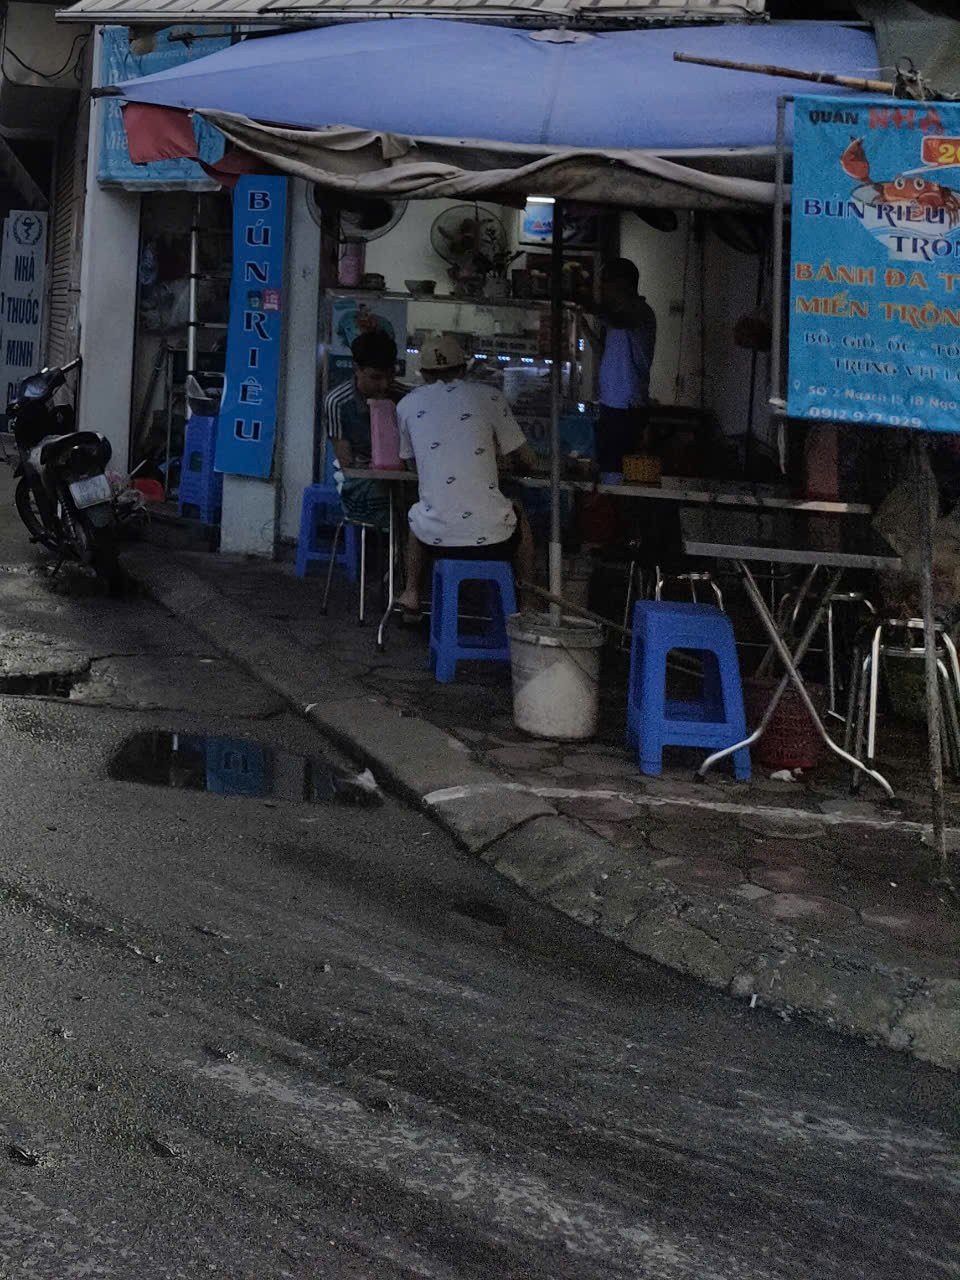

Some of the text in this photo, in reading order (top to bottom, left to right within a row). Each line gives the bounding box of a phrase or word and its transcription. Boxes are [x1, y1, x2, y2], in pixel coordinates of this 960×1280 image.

[804, 193, 946, 228] BÚN RIÊU
[795, 258, 875, 286] BÁNH
[885, 269, 927, 290] ĐA
[7, 289, 39, 325] THUỐC
[6, 340, 34, 368] MINH
[808, 406, 848, 419] 0912
